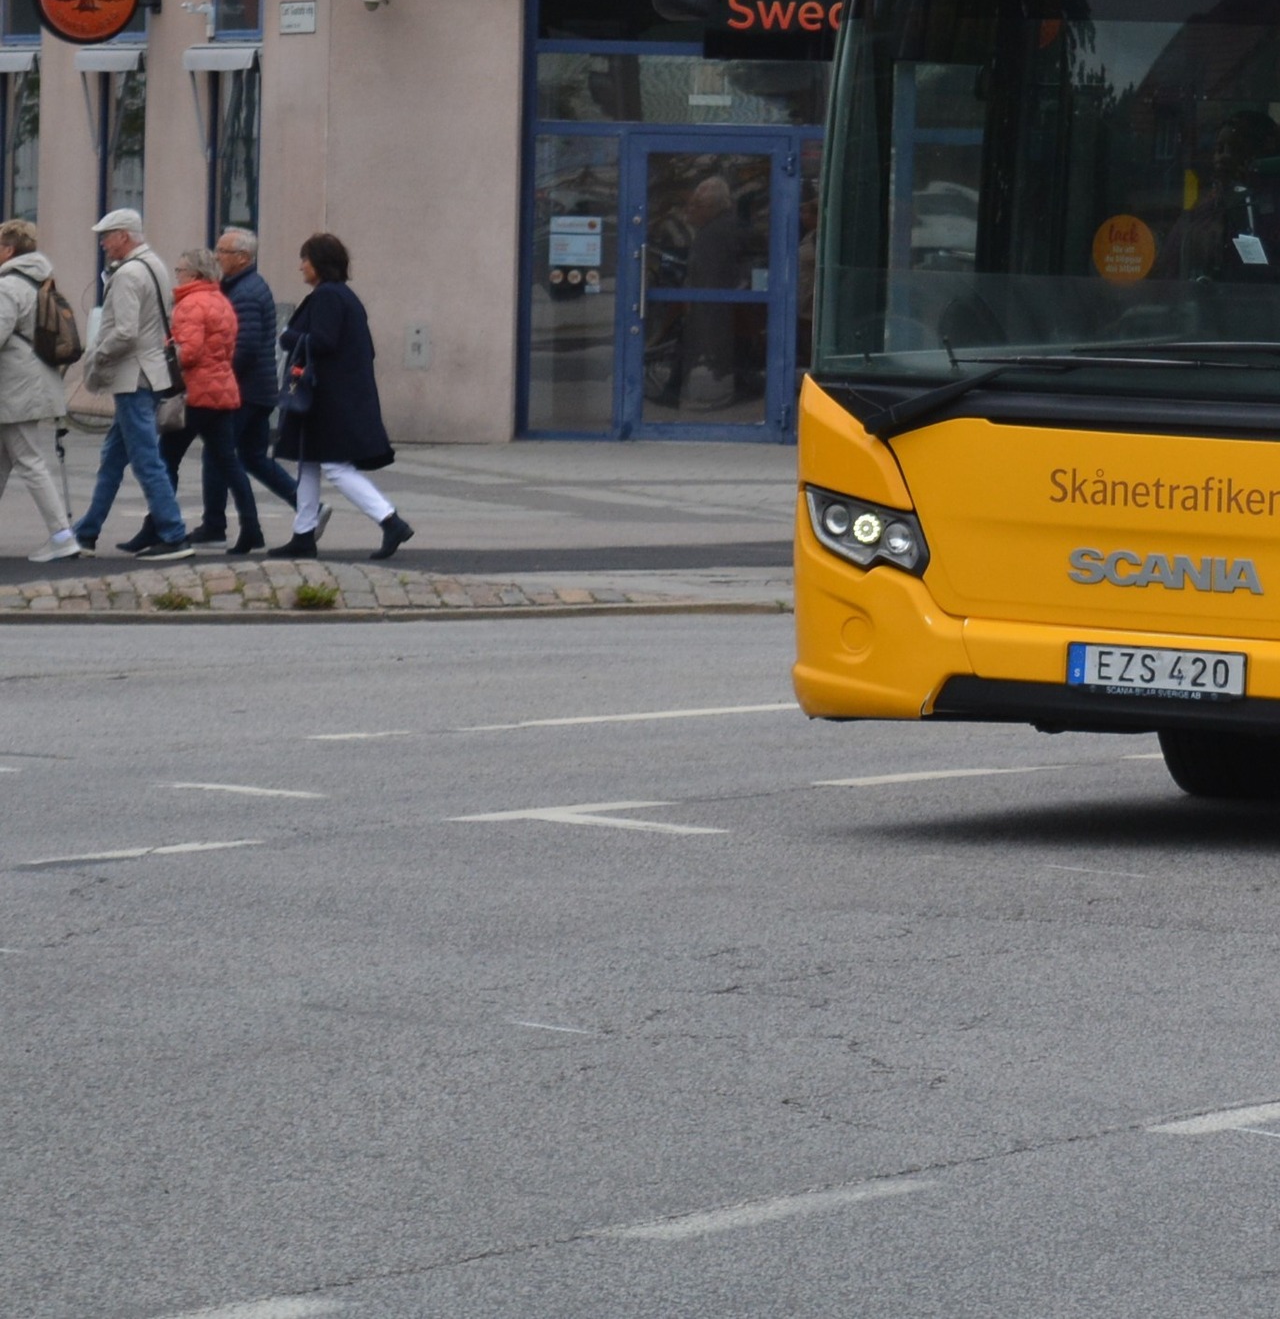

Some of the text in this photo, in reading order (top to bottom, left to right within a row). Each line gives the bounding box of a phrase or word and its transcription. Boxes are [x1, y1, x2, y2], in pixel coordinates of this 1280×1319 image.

[1067, 547, 1265, 595] SCANIA
[1097, 649, 1231, 688] EZS 420
[1190, 691, 1202, 700] AB
